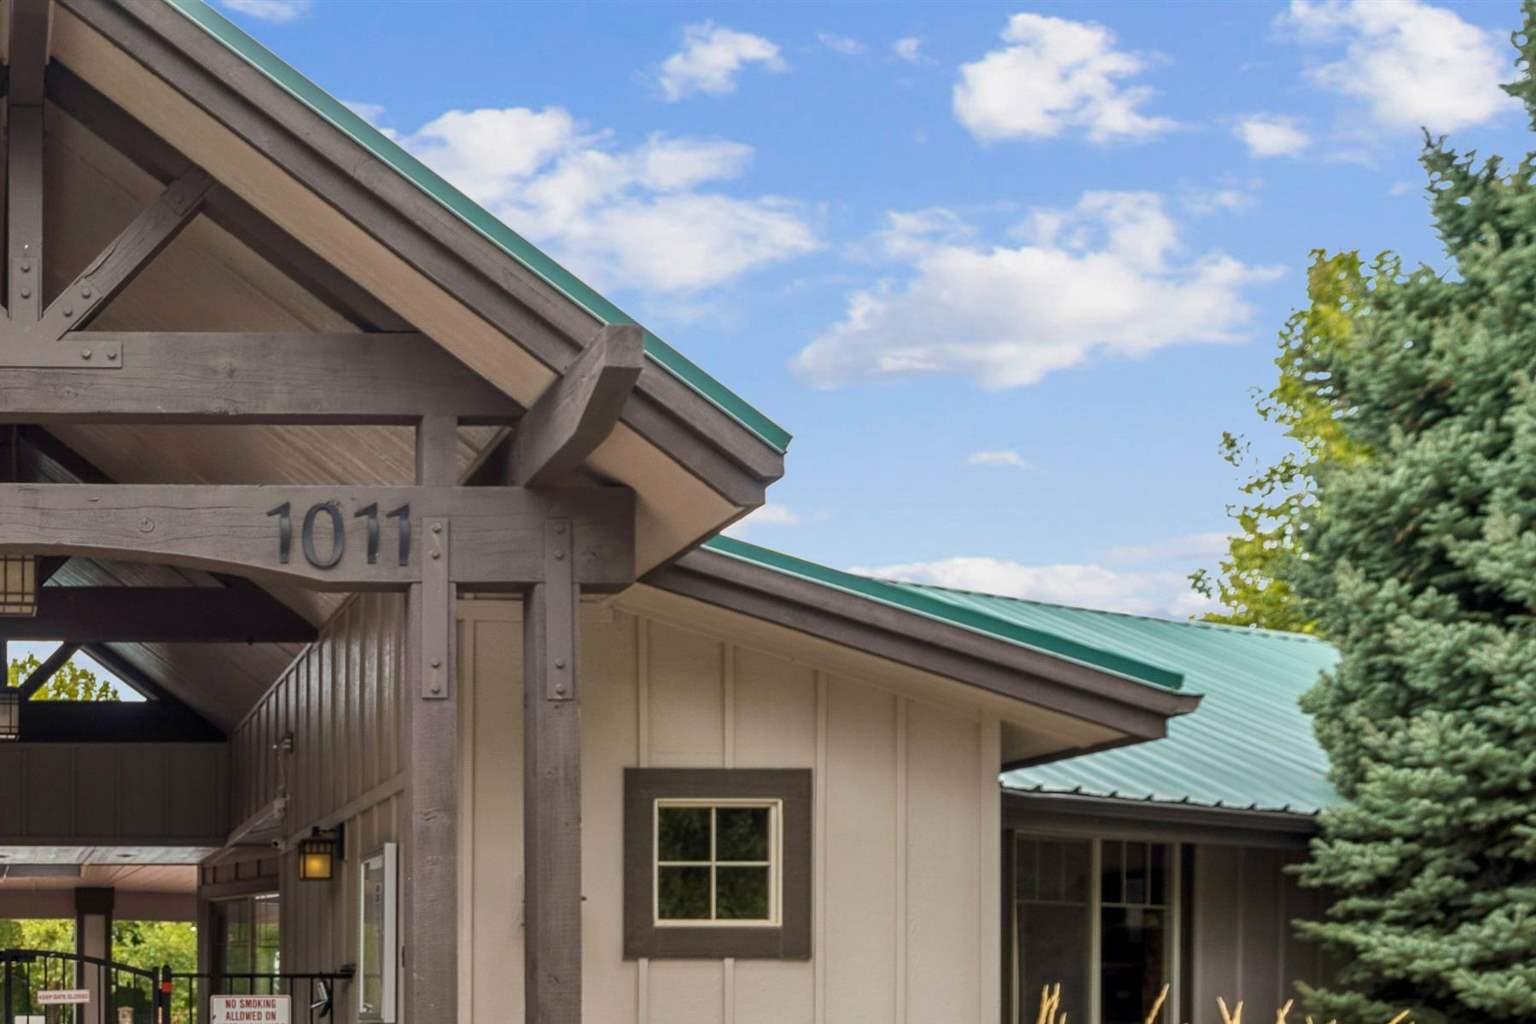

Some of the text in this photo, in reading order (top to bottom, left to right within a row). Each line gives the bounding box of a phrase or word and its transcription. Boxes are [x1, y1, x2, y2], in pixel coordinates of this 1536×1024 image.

[267, 501, 412, 569] 1011
[225, 999, 276, 1009] NO SMOKING
[225, 1011, 277, 1021] ALLOWED ON
